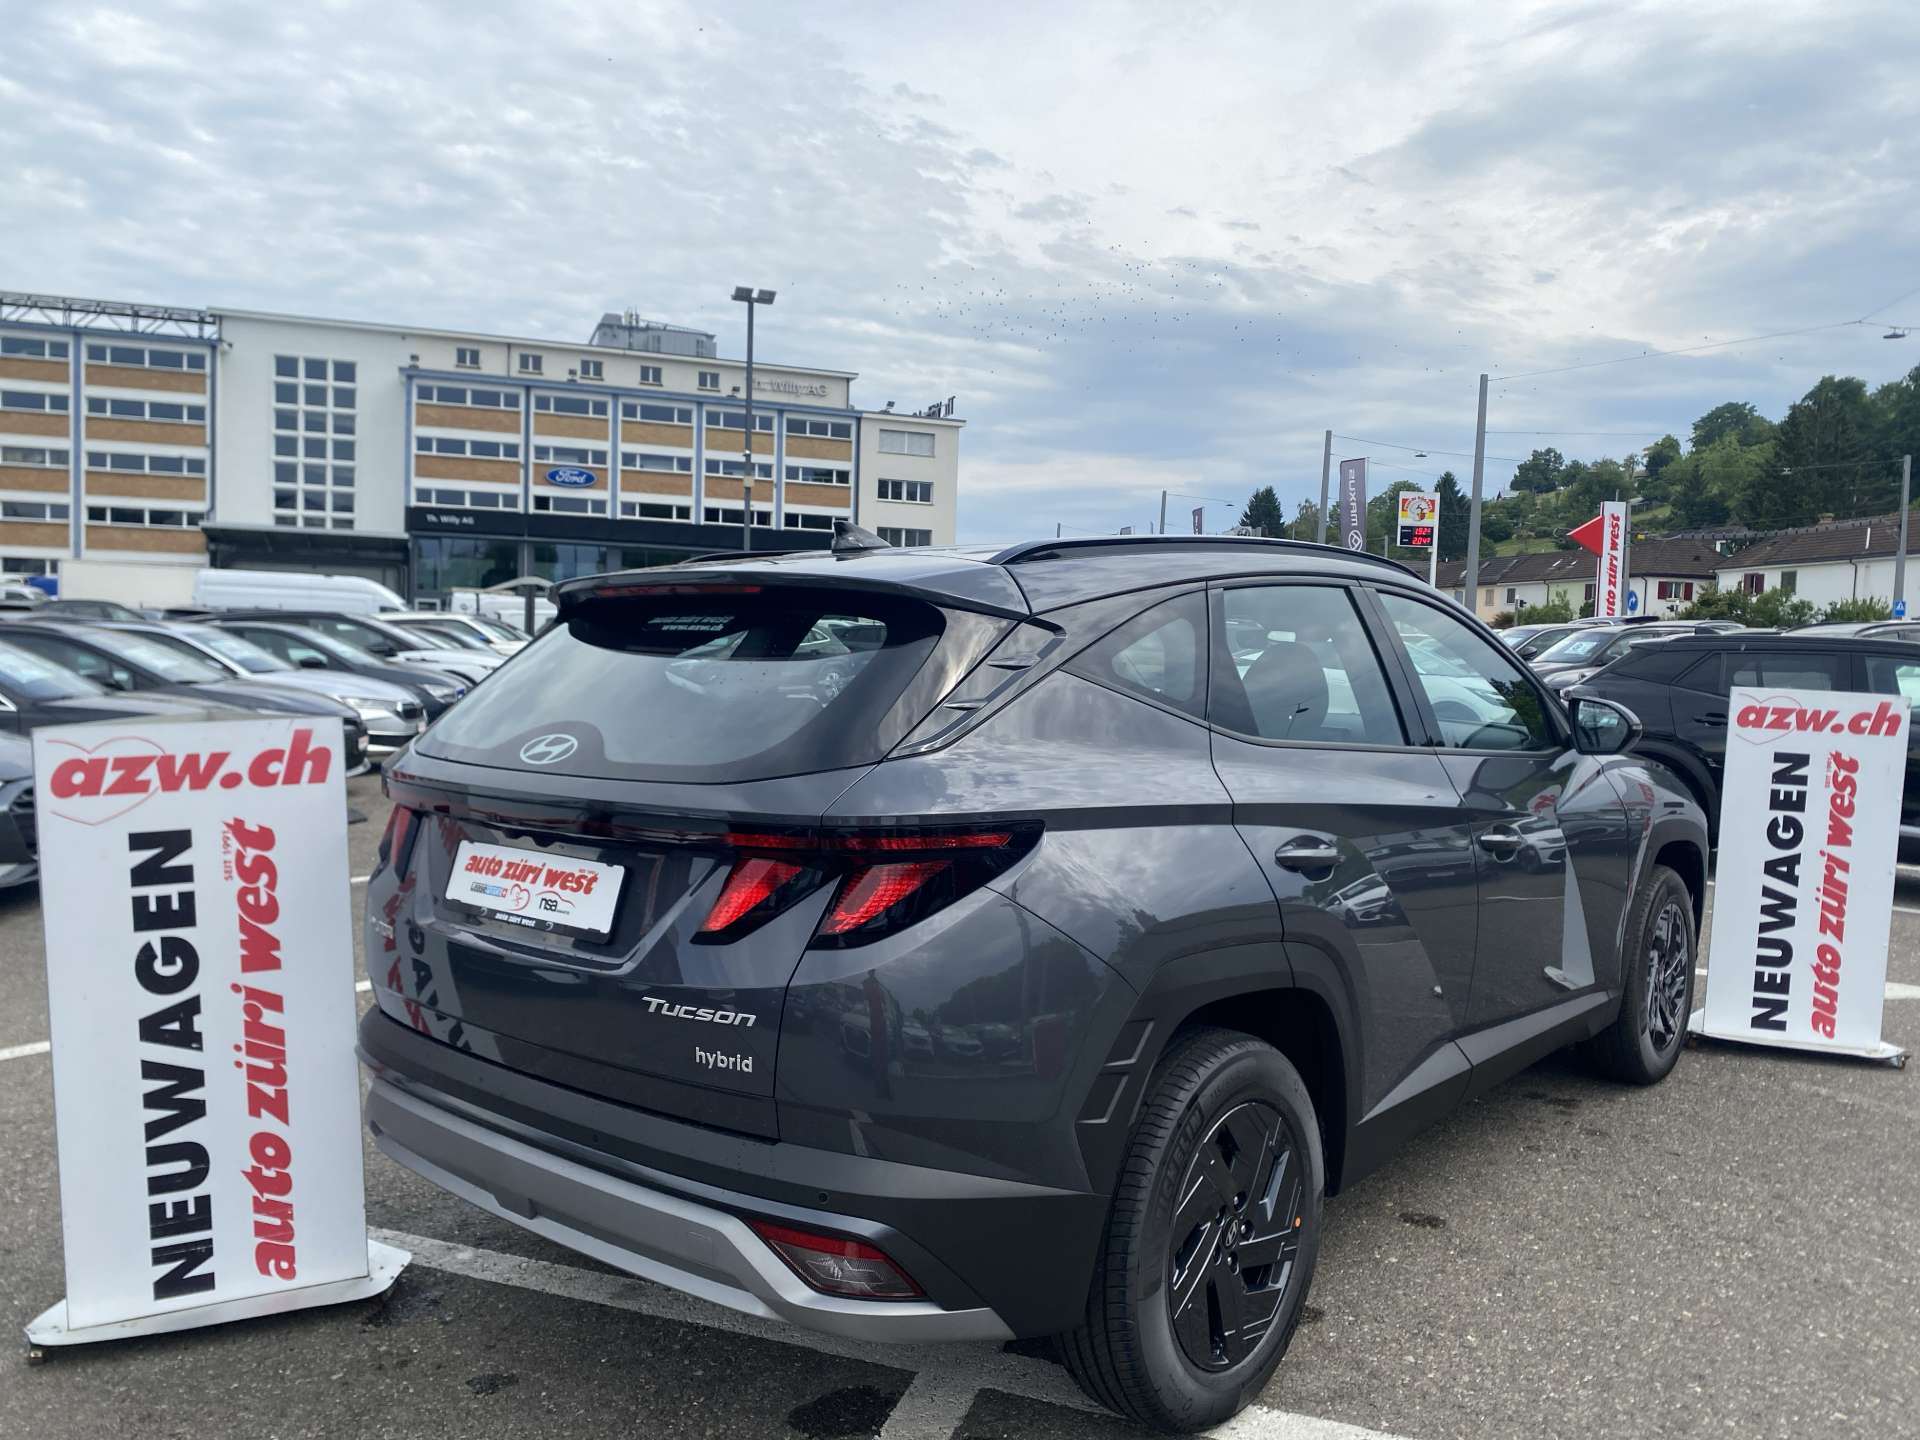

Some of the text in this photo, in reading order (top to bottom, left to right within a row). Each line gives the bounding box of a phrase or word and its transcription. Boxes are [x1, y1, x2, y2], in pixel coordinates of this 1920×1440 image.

[805, 383, 829, 398] AG
[555, 468, 586, 484] Ford
[1348, 468, 1358, 526] MAXUS
[1610, 513, 1620, 551] west
[1605, 590, 1616, 617] uto
[1737, 702, 1902, 736] azw.ch
[50, 730, 332, 798] azw.ch
[465, 853, 600, 895] auto züri west
[1750, 752, 1811, 1032] NEUWAGEN
[538, 897, 558, 913] nsa
[1811, 750, 1860, 1040] auto züri west
[128, 829, 215, 1300] NEUWAGEN
[223, 816, 297, 1282] auto züri west
[695, 1046, 753, 1073] hybrid
